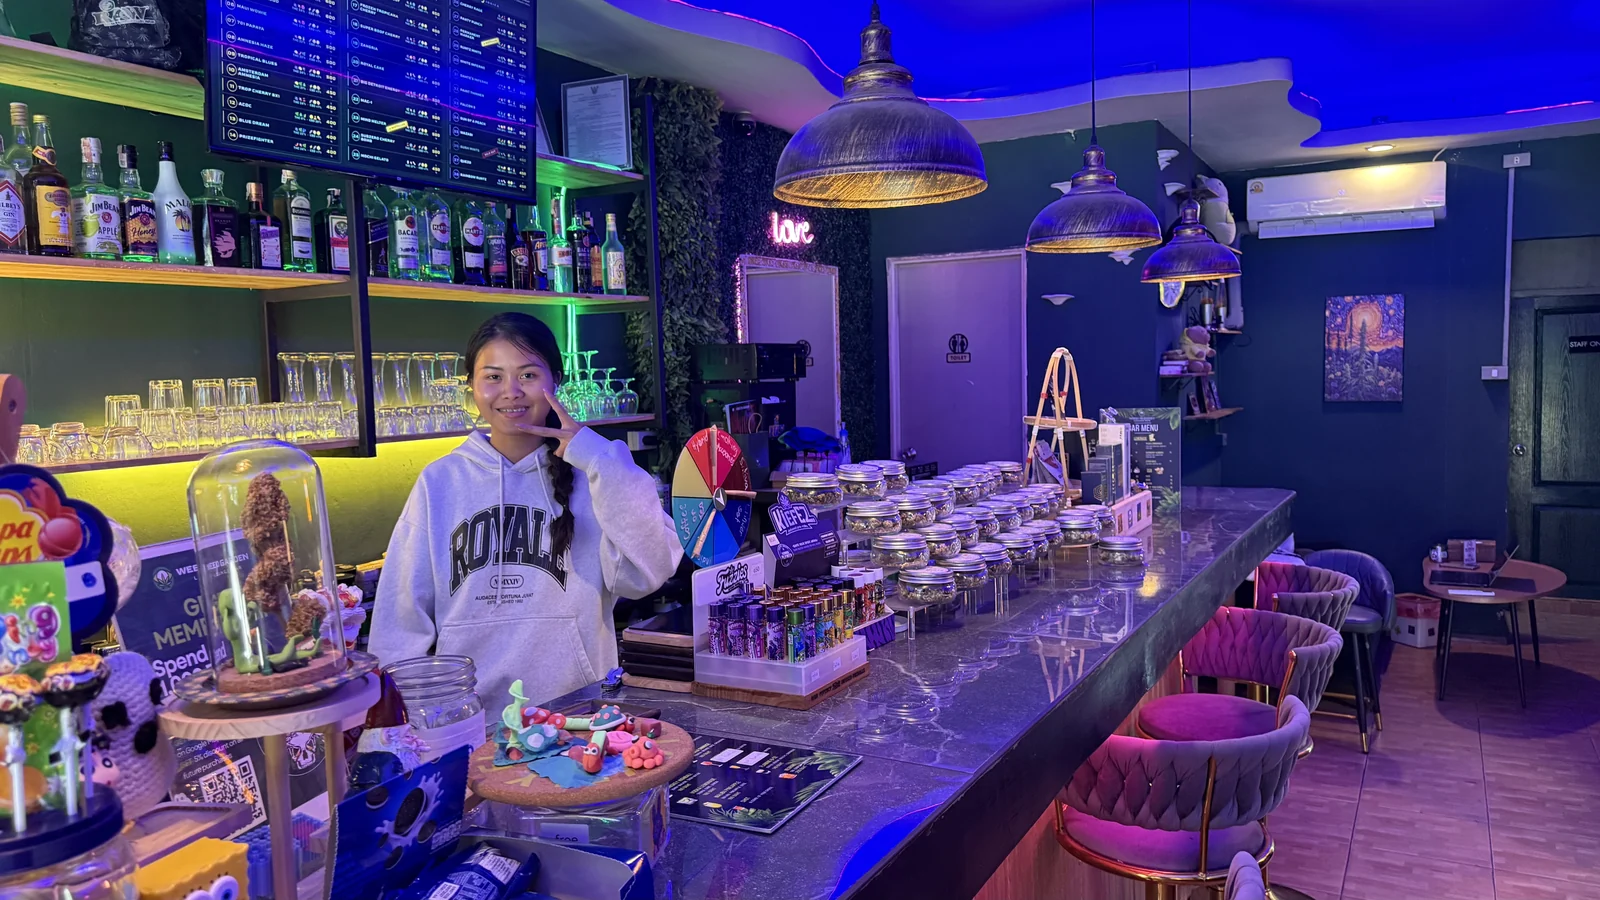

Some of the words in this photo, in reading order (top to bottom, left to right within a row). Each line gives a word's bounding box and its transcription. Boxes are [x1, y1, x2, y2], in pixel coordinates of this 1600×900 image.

[238, 53, 261, 62] TROPICAL
[238, 67, 268, 78] AMSTERDAM
[0, 202, 21, 211] ILBEY'S
[90, 201, 102, 213] JIM
[130, 205, 141, 216] JIM
[165, 199, 191, 212] MALI
[98, 226, 117, 235] APPLE
[132, 227, 156, 237] Honey
[772, 212, 814, 244] love
[220, 553, 249, 566] GADEN
[153, 644, 209, 677] Spend
[186, 741, 208, 755] Google
[183, 767, 200, 779] future
